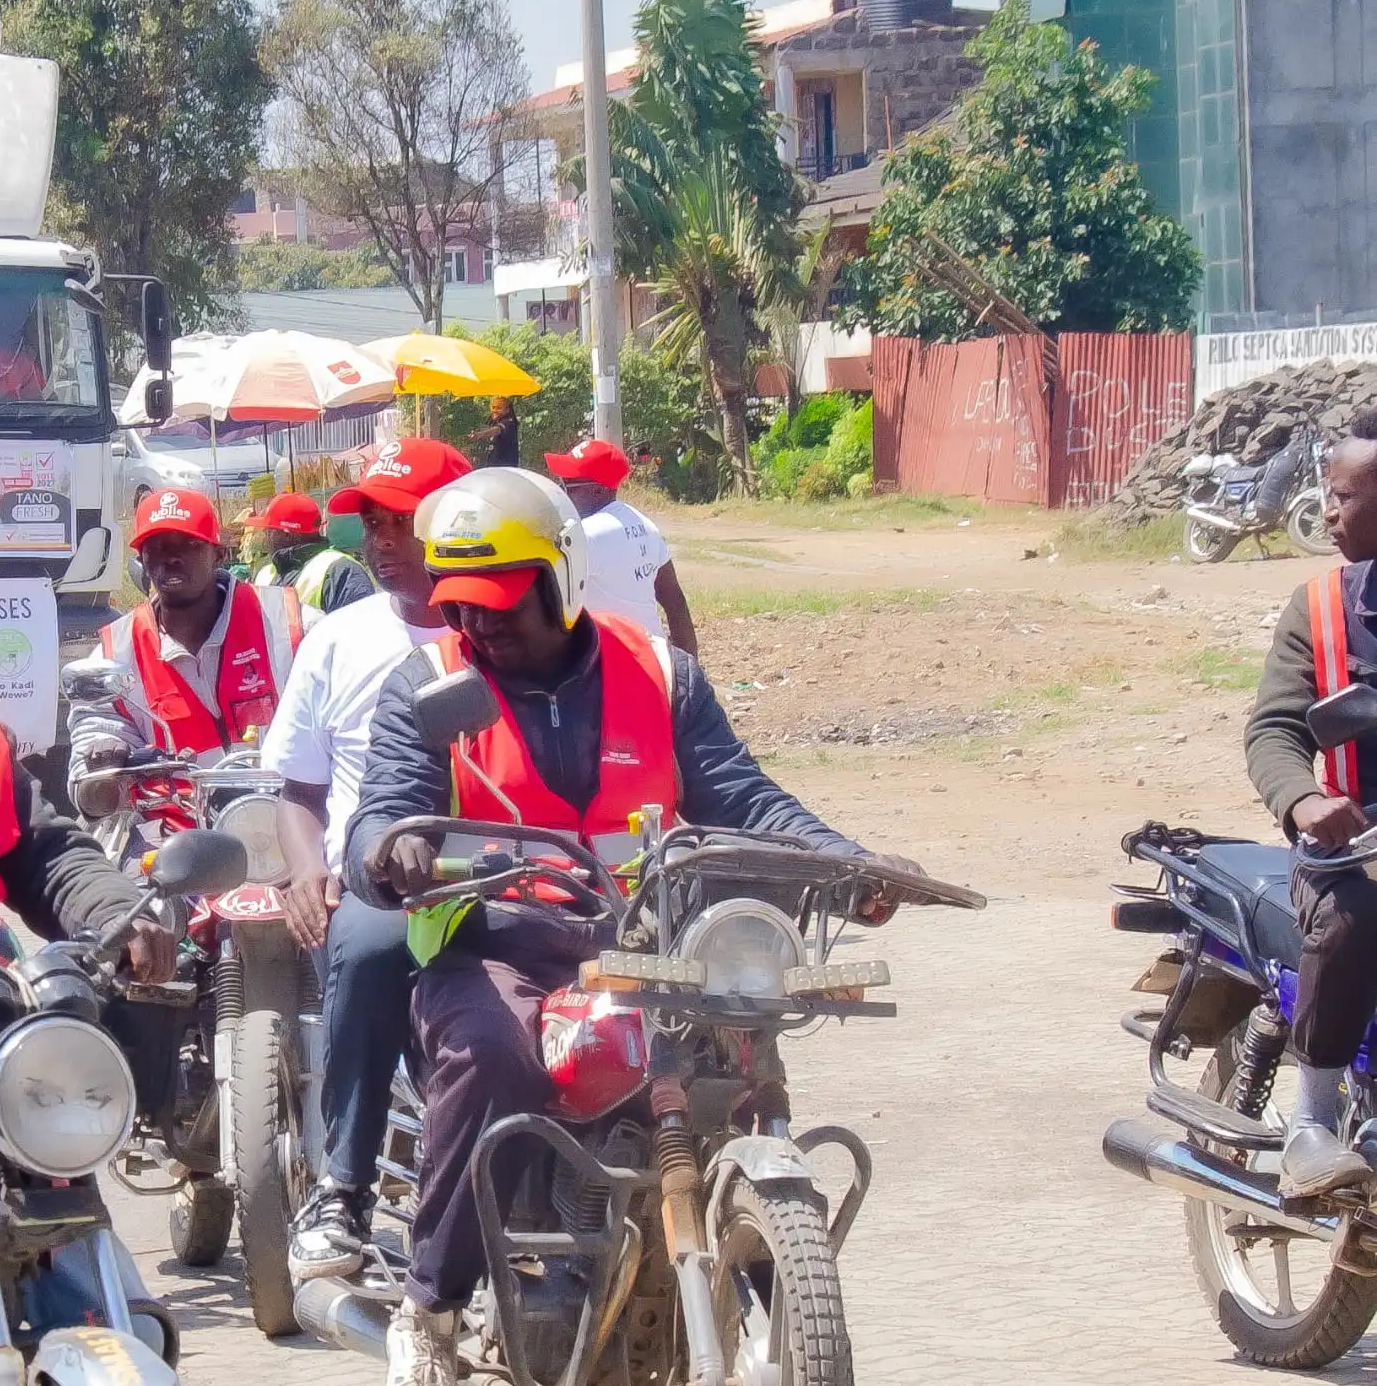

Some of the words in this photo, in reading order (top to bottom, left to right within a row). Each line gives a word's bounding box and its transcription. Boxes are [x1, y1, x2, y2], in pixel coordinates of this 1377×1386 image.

[1351, 323, 1377, 355] SYS
[16, 492, 53, 504] TANO
[16, 506, 54, 518] FRESH
